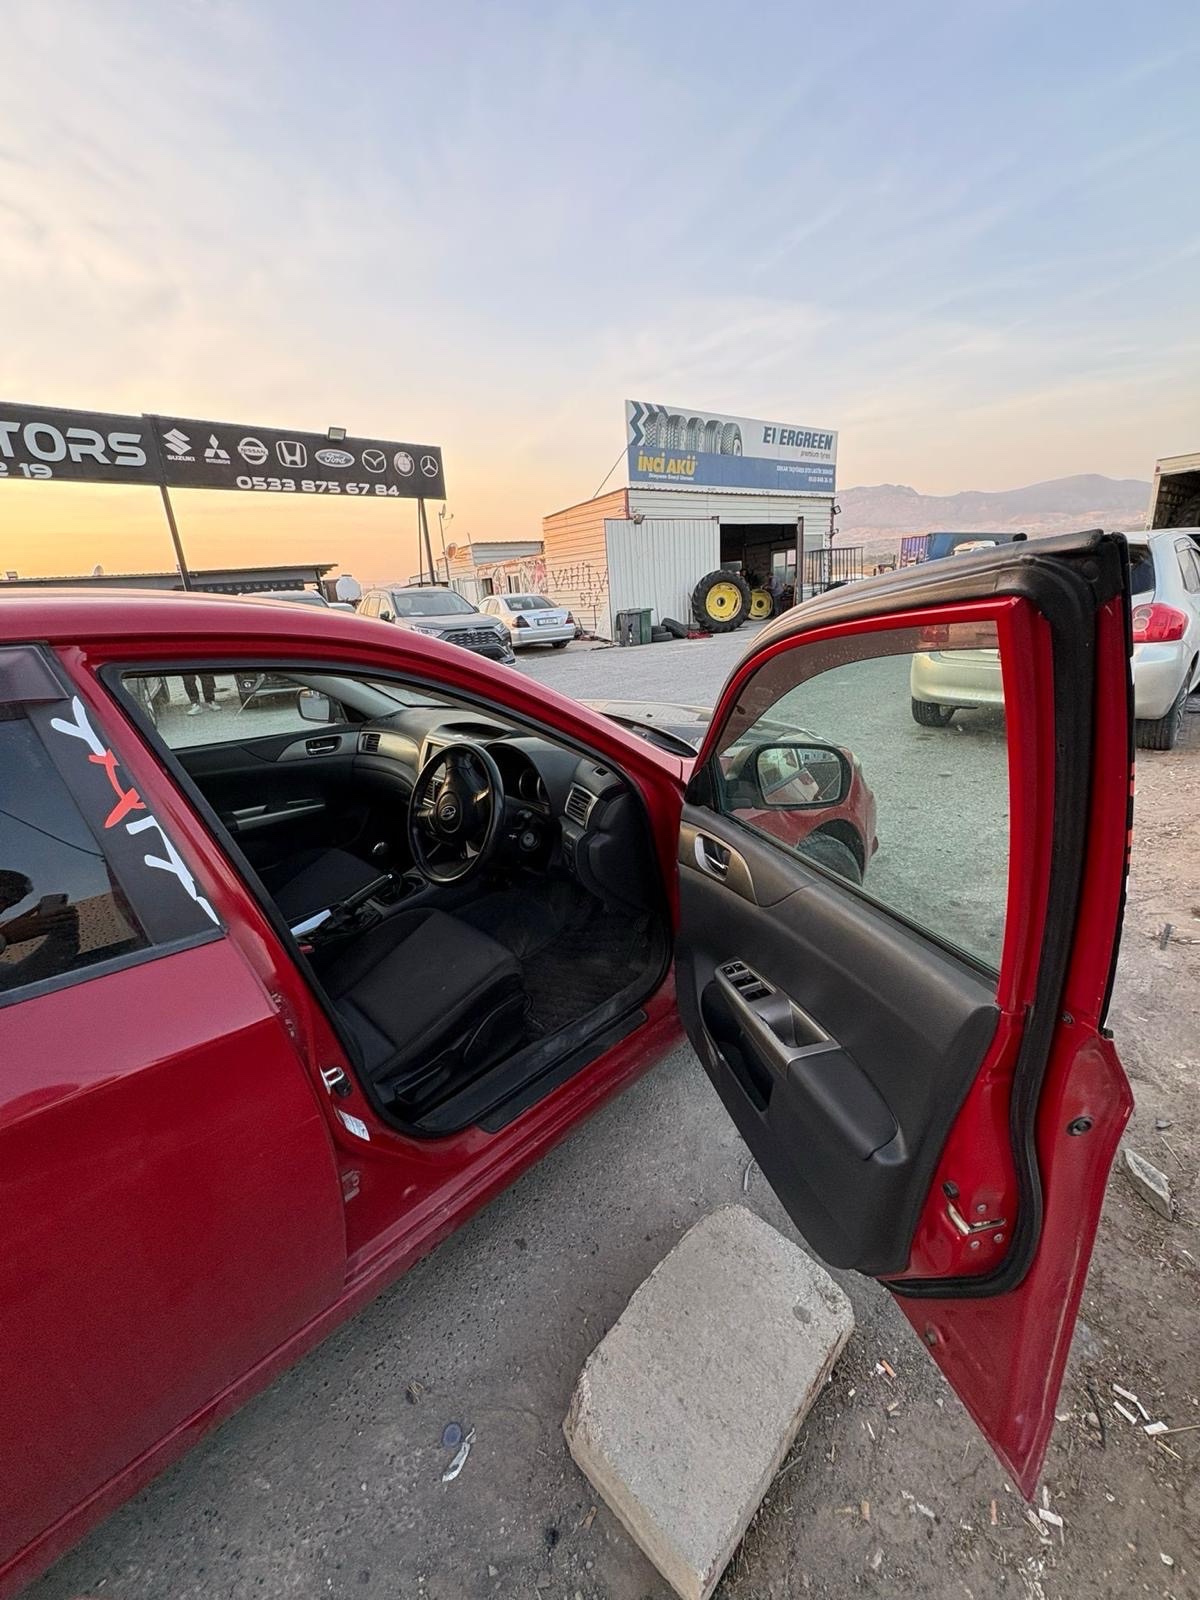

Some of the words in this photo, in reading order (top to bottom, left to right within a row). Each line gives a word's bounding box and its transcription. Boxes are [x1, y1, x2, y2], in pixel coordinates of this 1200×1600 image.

[166, 454, 196, 462] SUZUKI
[241, 447, 266, 455] NISSAN
[325, 452, 346, 464] Ford
[18, 462, 53, 479] 19
[666, 455, 696, 476] AKÜ
[236, 475, 296, 492] 0533
[301, 479, 341, 494] 875
[345, 482, 370, 495] 67
[375, 484, 400, 497] 84
